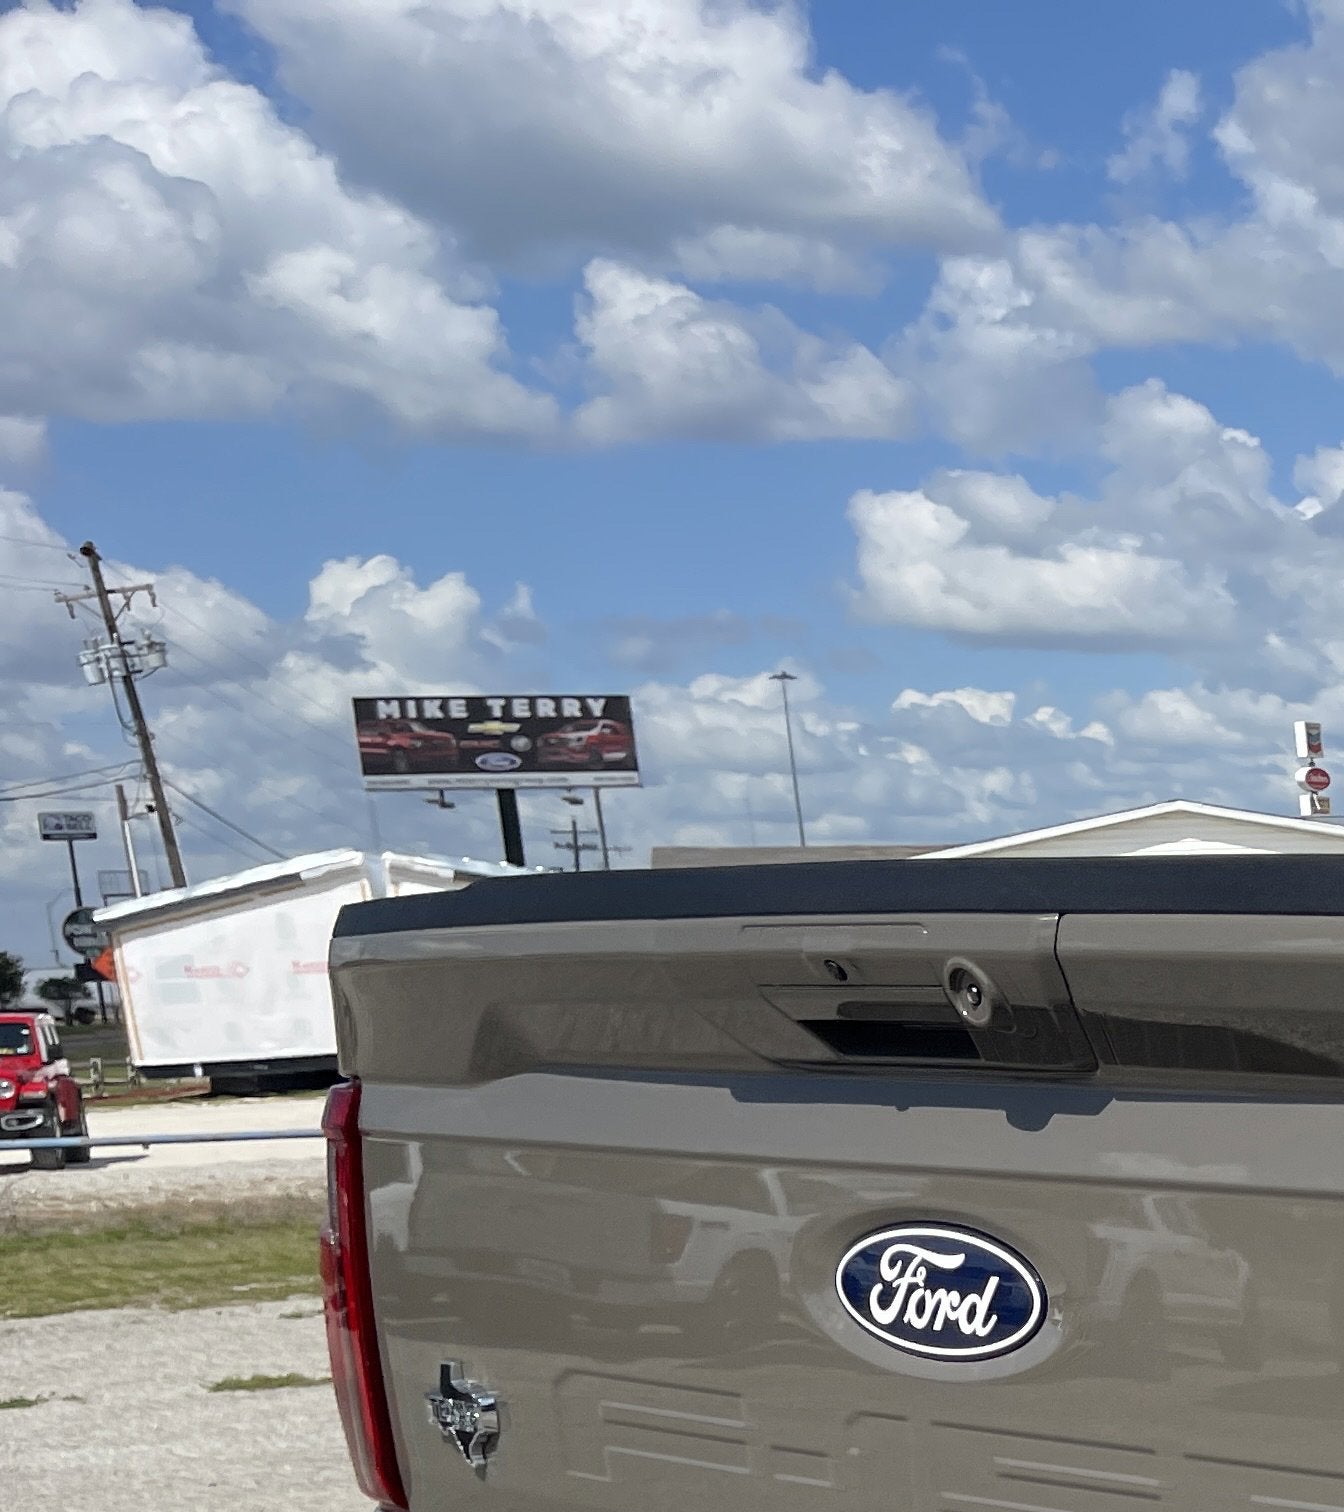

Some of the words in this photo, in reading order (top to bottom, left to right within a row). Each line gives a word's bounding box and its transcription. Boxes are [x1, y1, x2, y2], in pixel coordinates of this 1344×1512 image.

[377, 699, 469, 719] MIKE
[487, 698, 606, 718] TERRY
[869, 1243, 1000, 1337] Ford
